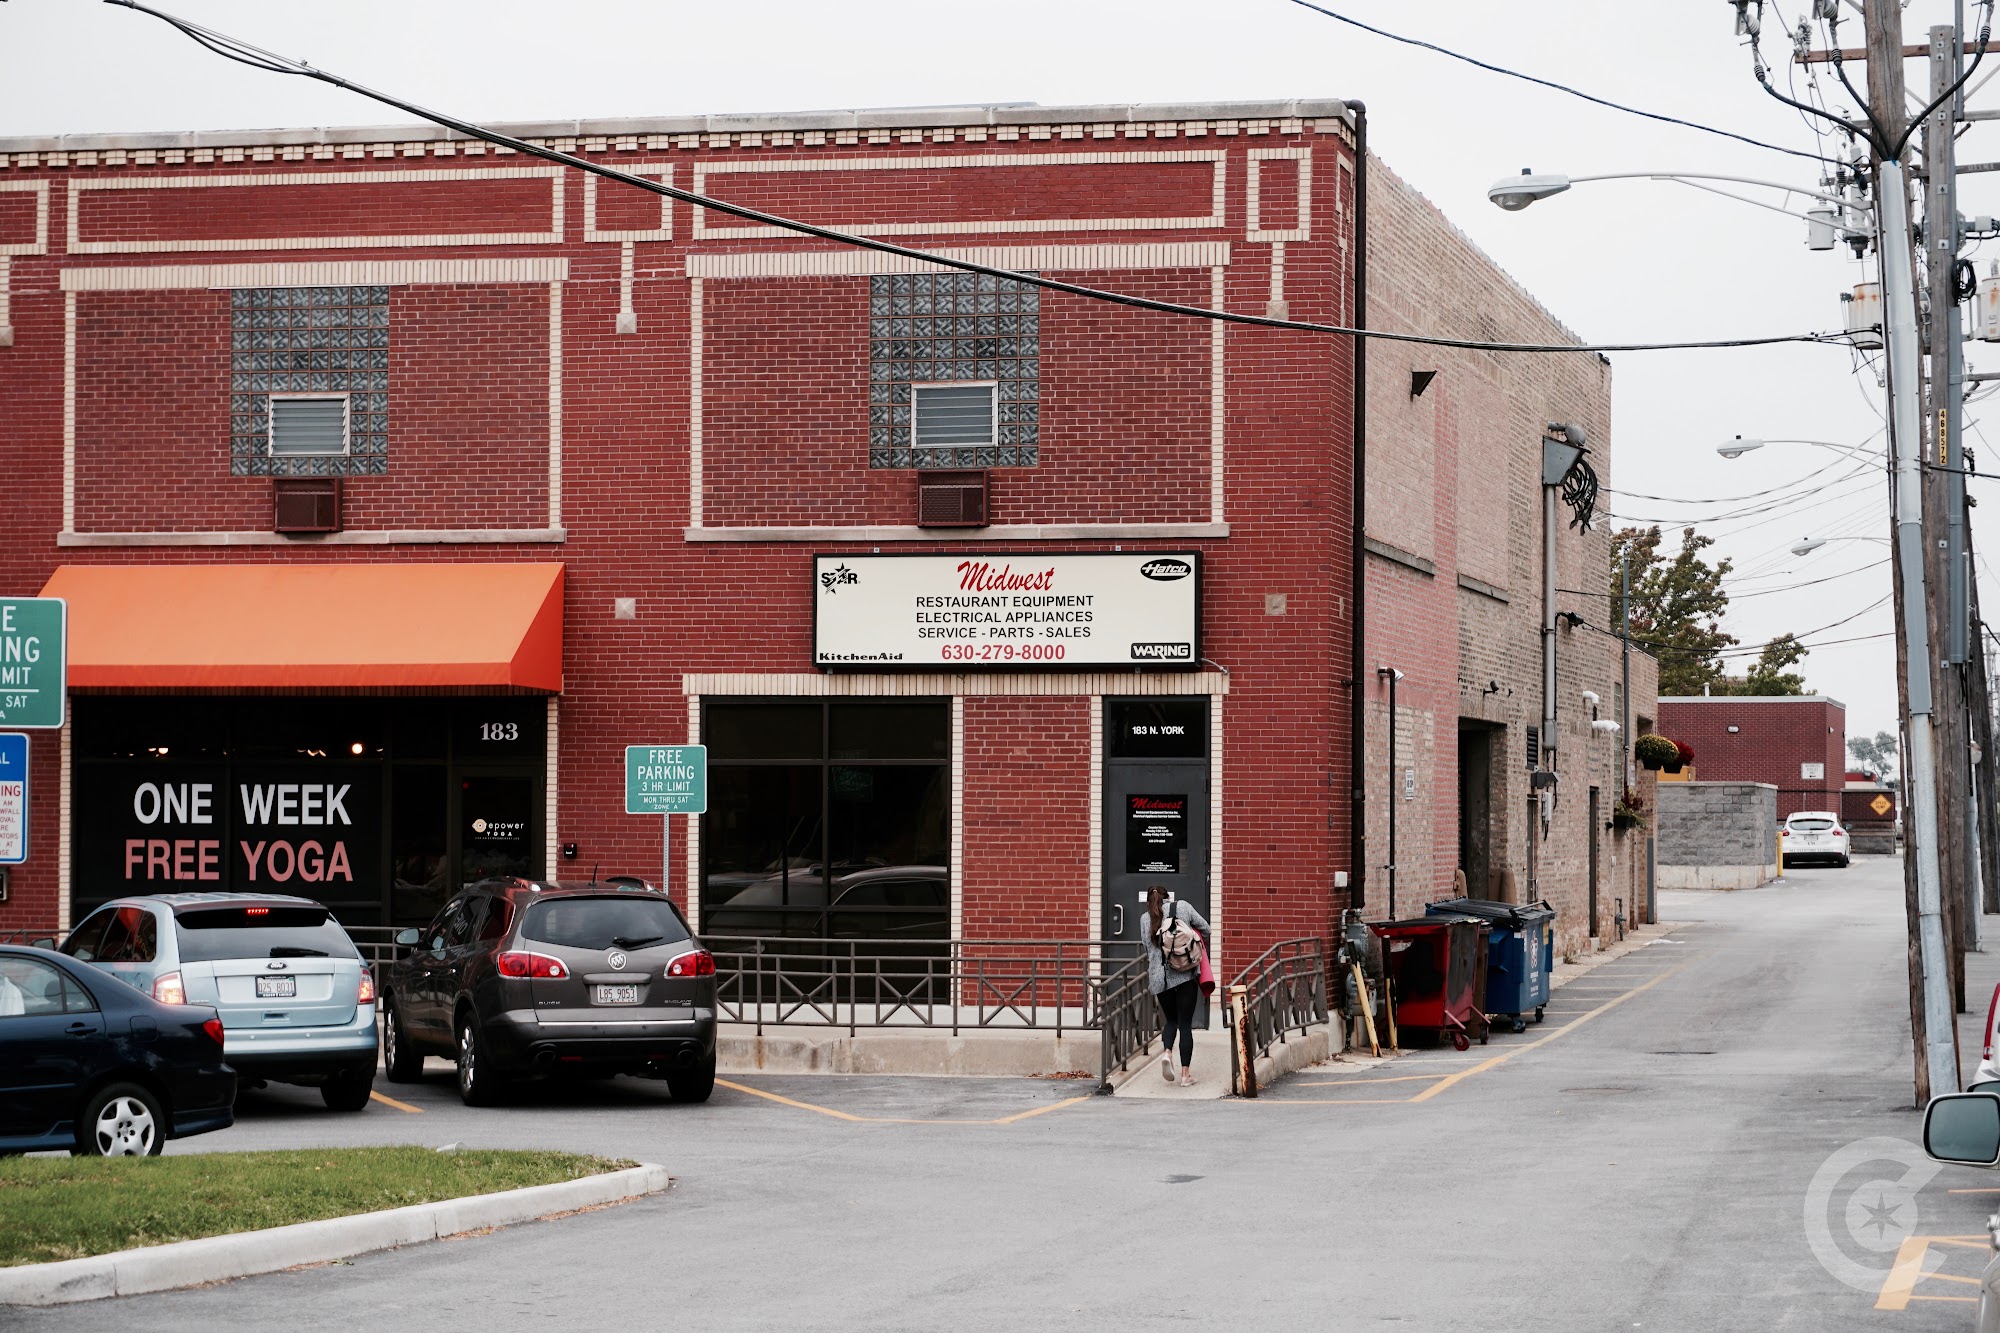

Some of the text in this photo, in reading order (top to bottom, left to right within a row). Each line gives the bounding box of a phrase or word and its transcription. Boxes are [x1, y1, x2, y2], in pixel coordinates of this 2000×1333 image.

[957, 560, 1055, 592] Midwest
[1141, 563, 1189, 577] Hatco
[916, 595, 1094, 608] RESTAURANT EQUIPMENT
[916, 611, 1093, 623] ELECTRICAL APPLIANCES
[918, 627, 977, 638] SERVICE
[990, 627, 1034, 638] PARTS
[1046, 626, 1091, 638] SALES
[819, 652, 904, 661] KitchenAid
[941, 644, 1066, 660] 630-279-8000
[1133, 645, 1189, 660] WARING
[479, 722, 519, 741] 183
[1132, 726, 1185, 735] 183 N. YORK
[650, 750, 682, 764] FREE
[638, 766, 694, 780] PARKING
[642, 782, 690, 791] 3 HR LIMIT
[133, 782, 352, 825] ONE WEEK
[1131, 797, 1183, 809] Midwest
[125, 839, 353, 882] FREE YOGA
[599, 988, 635, 999] L85 9053
